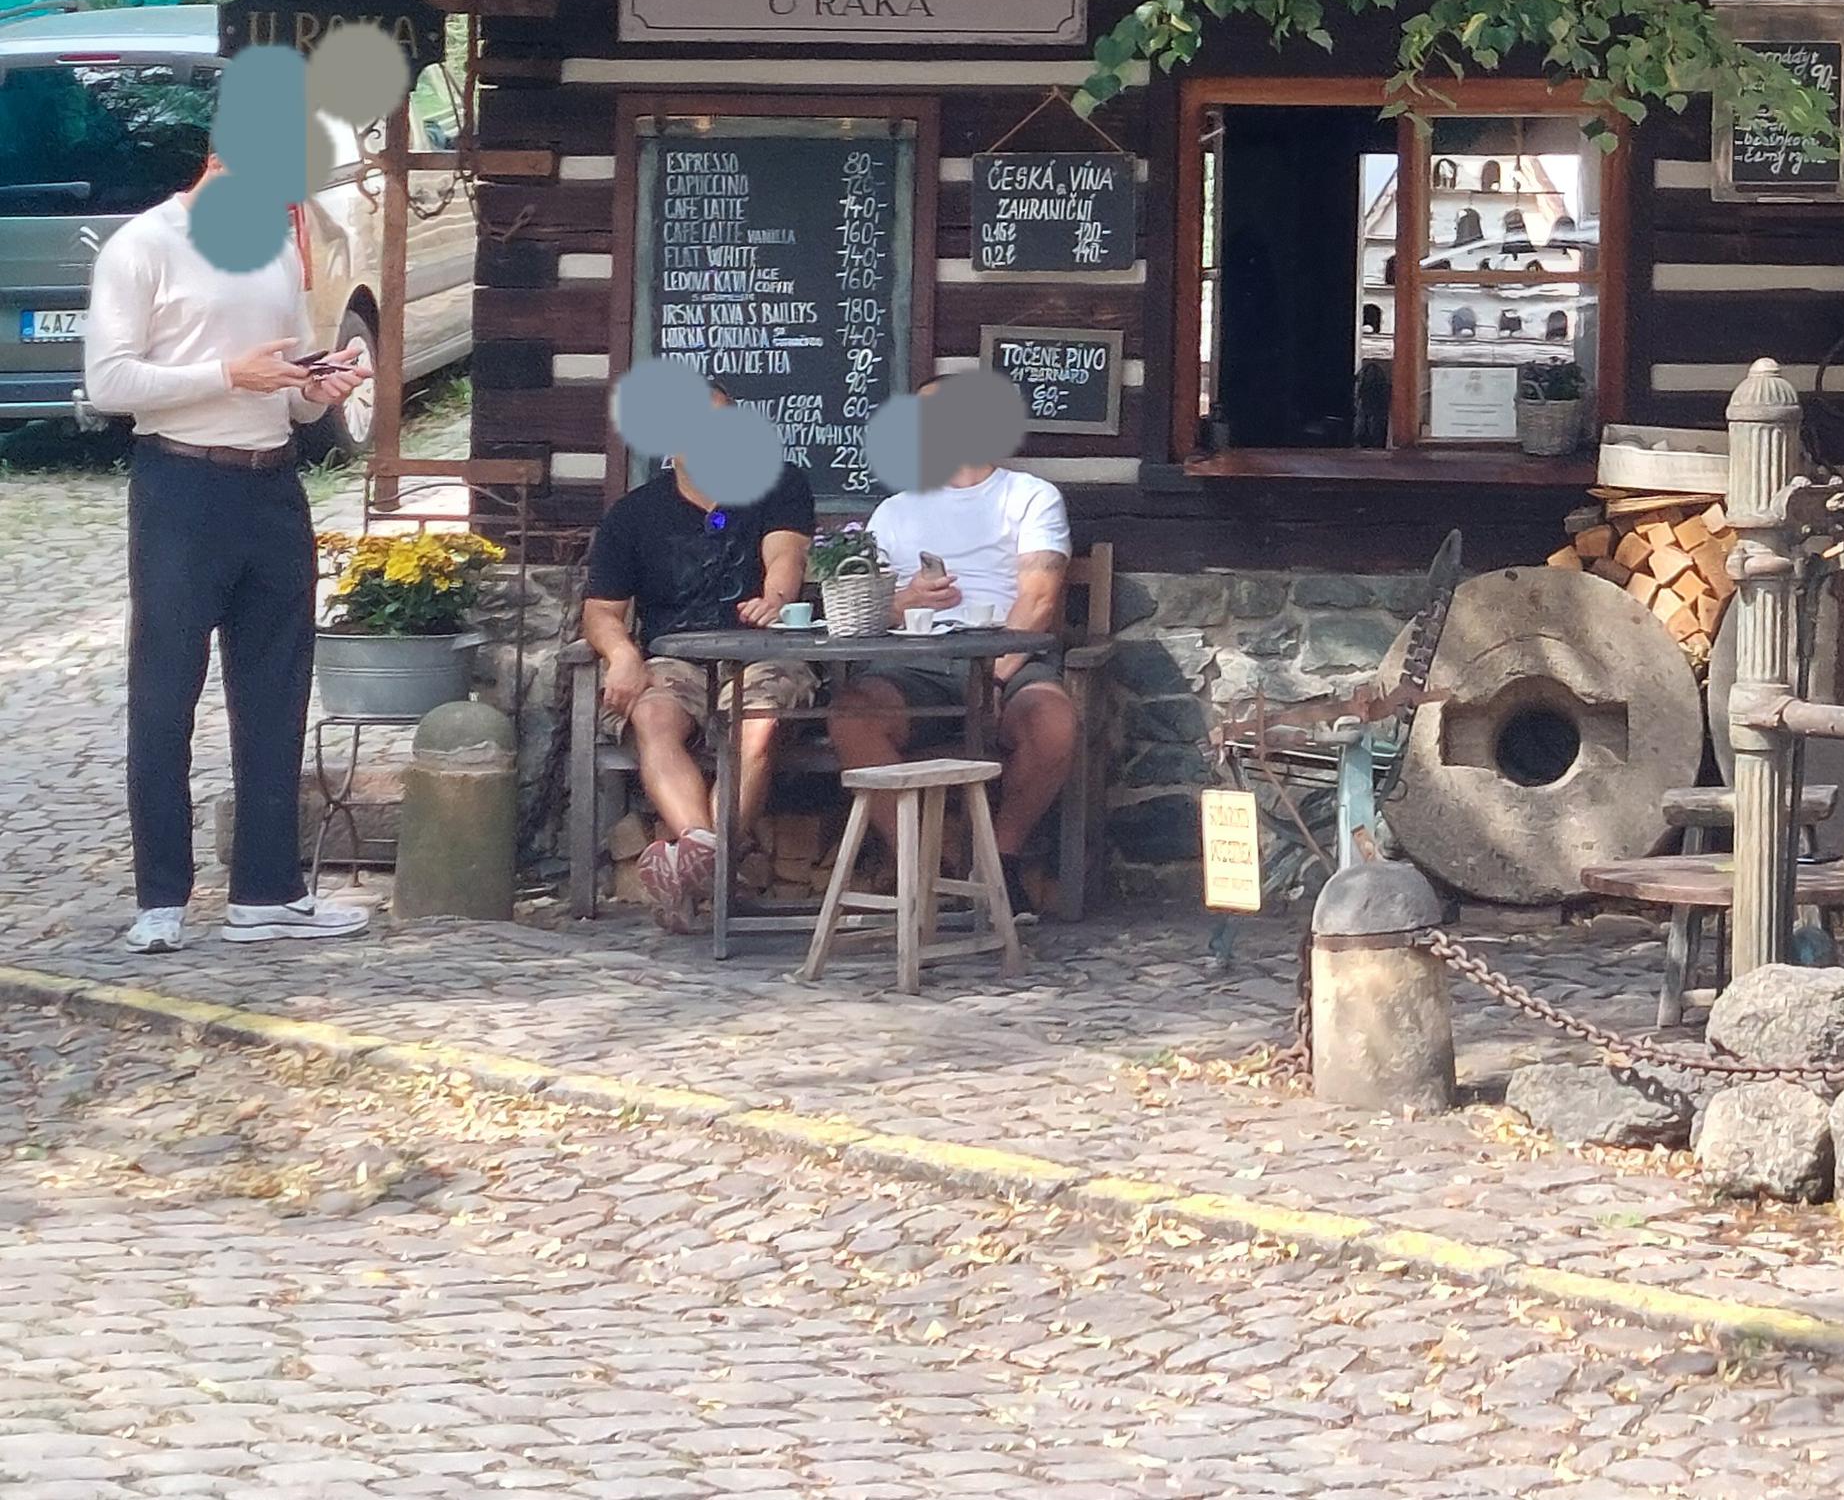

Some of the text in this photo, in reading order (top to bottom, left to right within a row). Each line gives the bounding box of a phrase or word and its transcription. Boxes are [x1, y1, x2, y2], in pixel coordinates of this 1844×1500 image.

[296, 12, 418, 58] RA
[666, 152, 739, 173] ESPRESSO
[988, 159, 1056, 190] ČESKÁ
[1070, 160, 1114, 191] VÍNA
[666, 174, 749, 195] CAPUCCINO
[703, 197, 749, 220] LATTE
[996, 192, 1096, 220] ZAHRANIČNÍ
[701, 221, 746, 243] LATTE
[835, 219, 886, 247] 160,-
[664, 243, 886, 269] FLAT WHITE 140,-
[835, 266, 883, 290] 160,-
[40, 313, 77, 333] 4AZ
[747, 303, 757, 325] S
[762, 302, 818, 325] BAILEYS
[837, 297, 886, 325] 180,-
[765, 350, 791, 375] TEA
[847, 348, 882, 375] 90,-
[1000, 341, 1062, 368] TOČENÉ
[845, 371, 879, 394] 90,-
[1032, 383, 1070, 401] 60,-
[784, 409, 822, 423] COLA
[787, 395, 823, 410] COCA
[843, 396, 879, 420] 60,-
[1031, 400, 1068, 417] 90,-
[843, 469, 879, 494] 55,-
